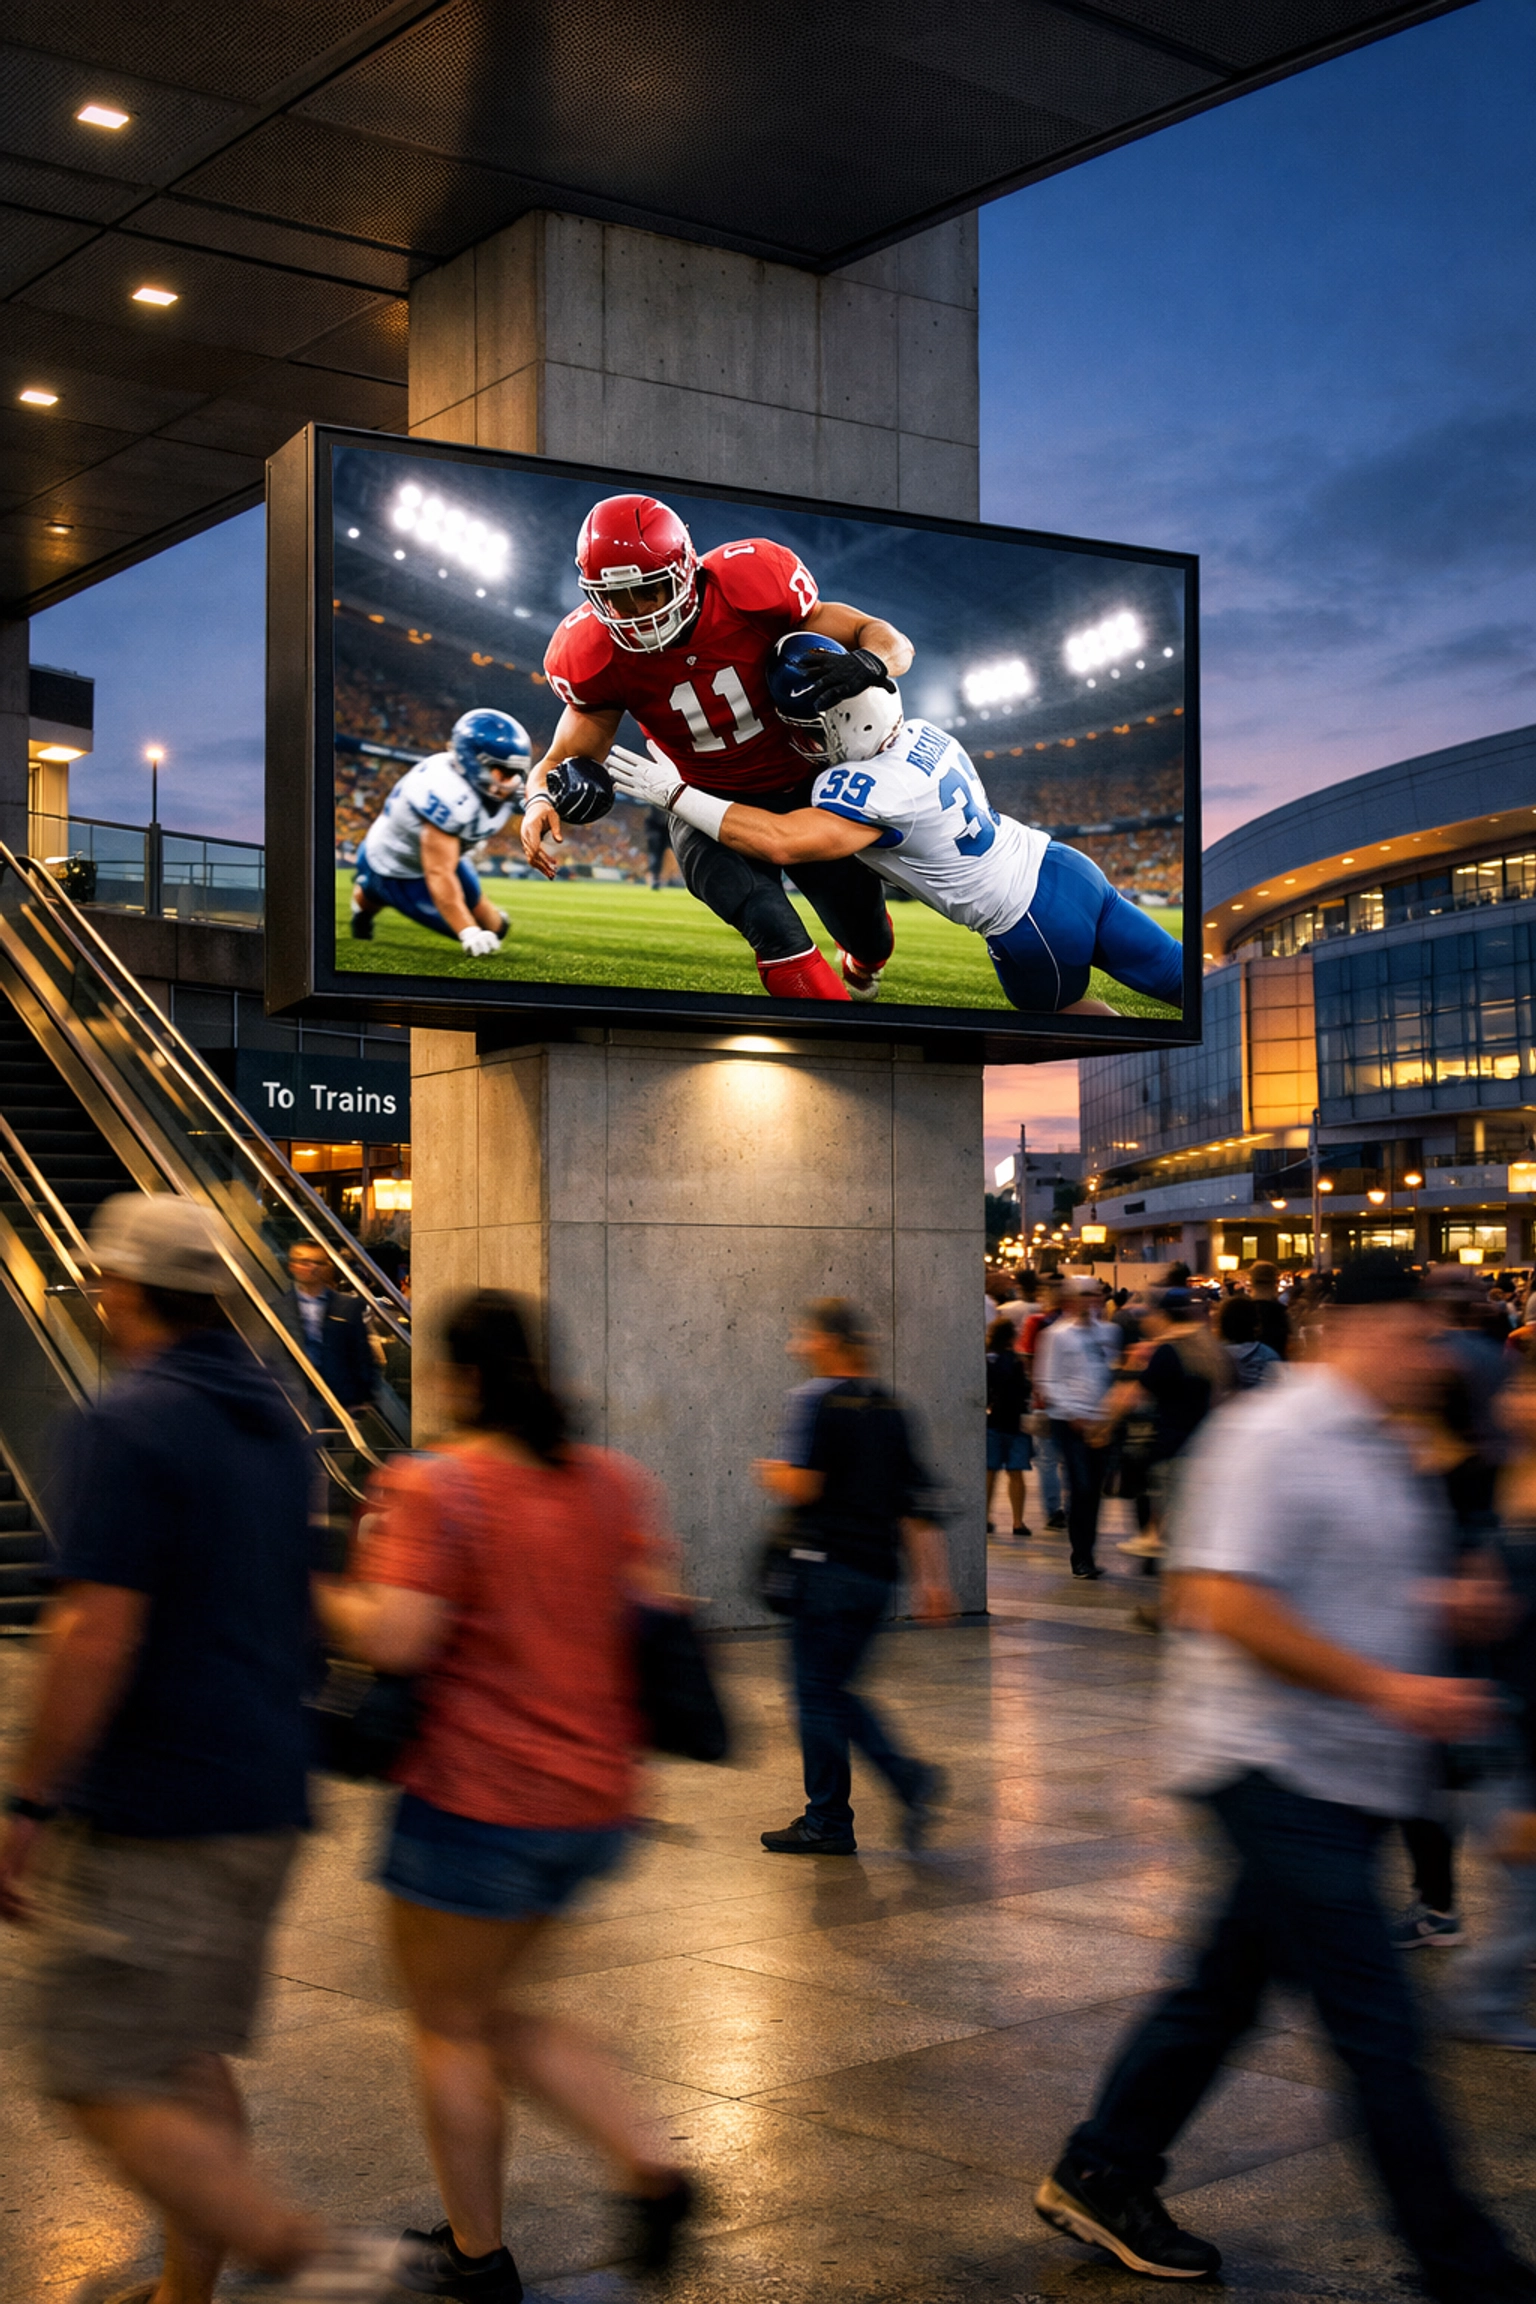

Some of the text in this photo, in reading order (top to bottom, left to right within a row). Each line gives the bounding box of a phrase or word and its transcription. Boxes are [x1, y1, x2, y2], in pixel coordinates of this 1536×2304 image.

[669, 665, 764, 753] 11
[938, 752, 1001, 858] 3
[262, 1081, 397, 1115] To Trains
